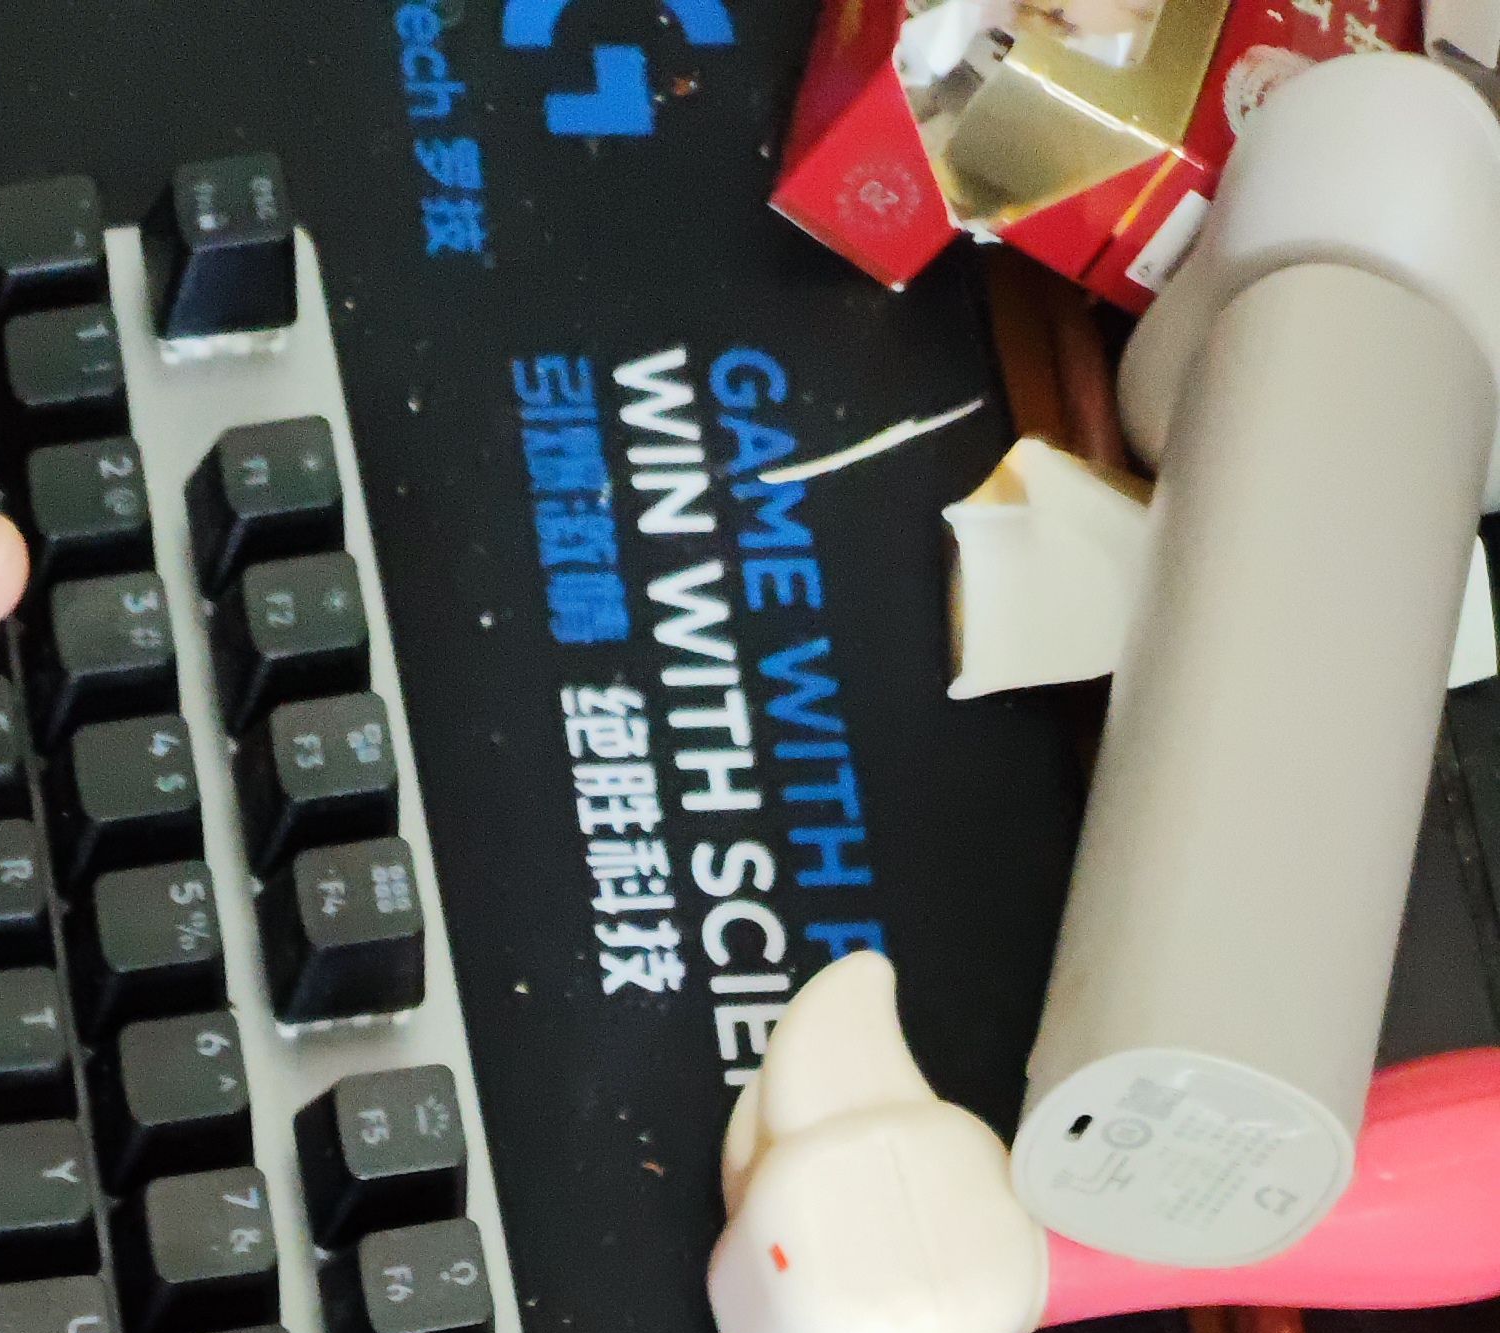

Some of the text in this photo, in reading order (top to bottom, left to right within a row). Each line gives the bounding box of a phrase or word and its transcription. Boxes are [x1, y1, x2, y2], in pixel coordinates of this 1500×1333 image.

[612, 346, 717, 534] WIN
[99, 456, 133, 479] 2
[708, 347, 824, 612] GAME
[123, 590, 161, 613] 3
[265, 591, 296, 626] F2
[647, 559, 762, 811] WITH
[150, 731, 189, 757] 4
[292, 733, 323, 769] F3
[758, 636, 874, 886] WITH
[560, 686, 686, 996] 绝胜科技
[168, 881, 205, 905] 5
[316, 878, 346, 914] F4
[20, 1006, 58, 1029] T
[197, 1030, 231, 1057] 6
[357, 1109, 392, 1145] F5
[42, 1158, 81, 1184] Y
[224, 1187, 261, 1211] 7
[381, 1265, 415, 1301] F6
